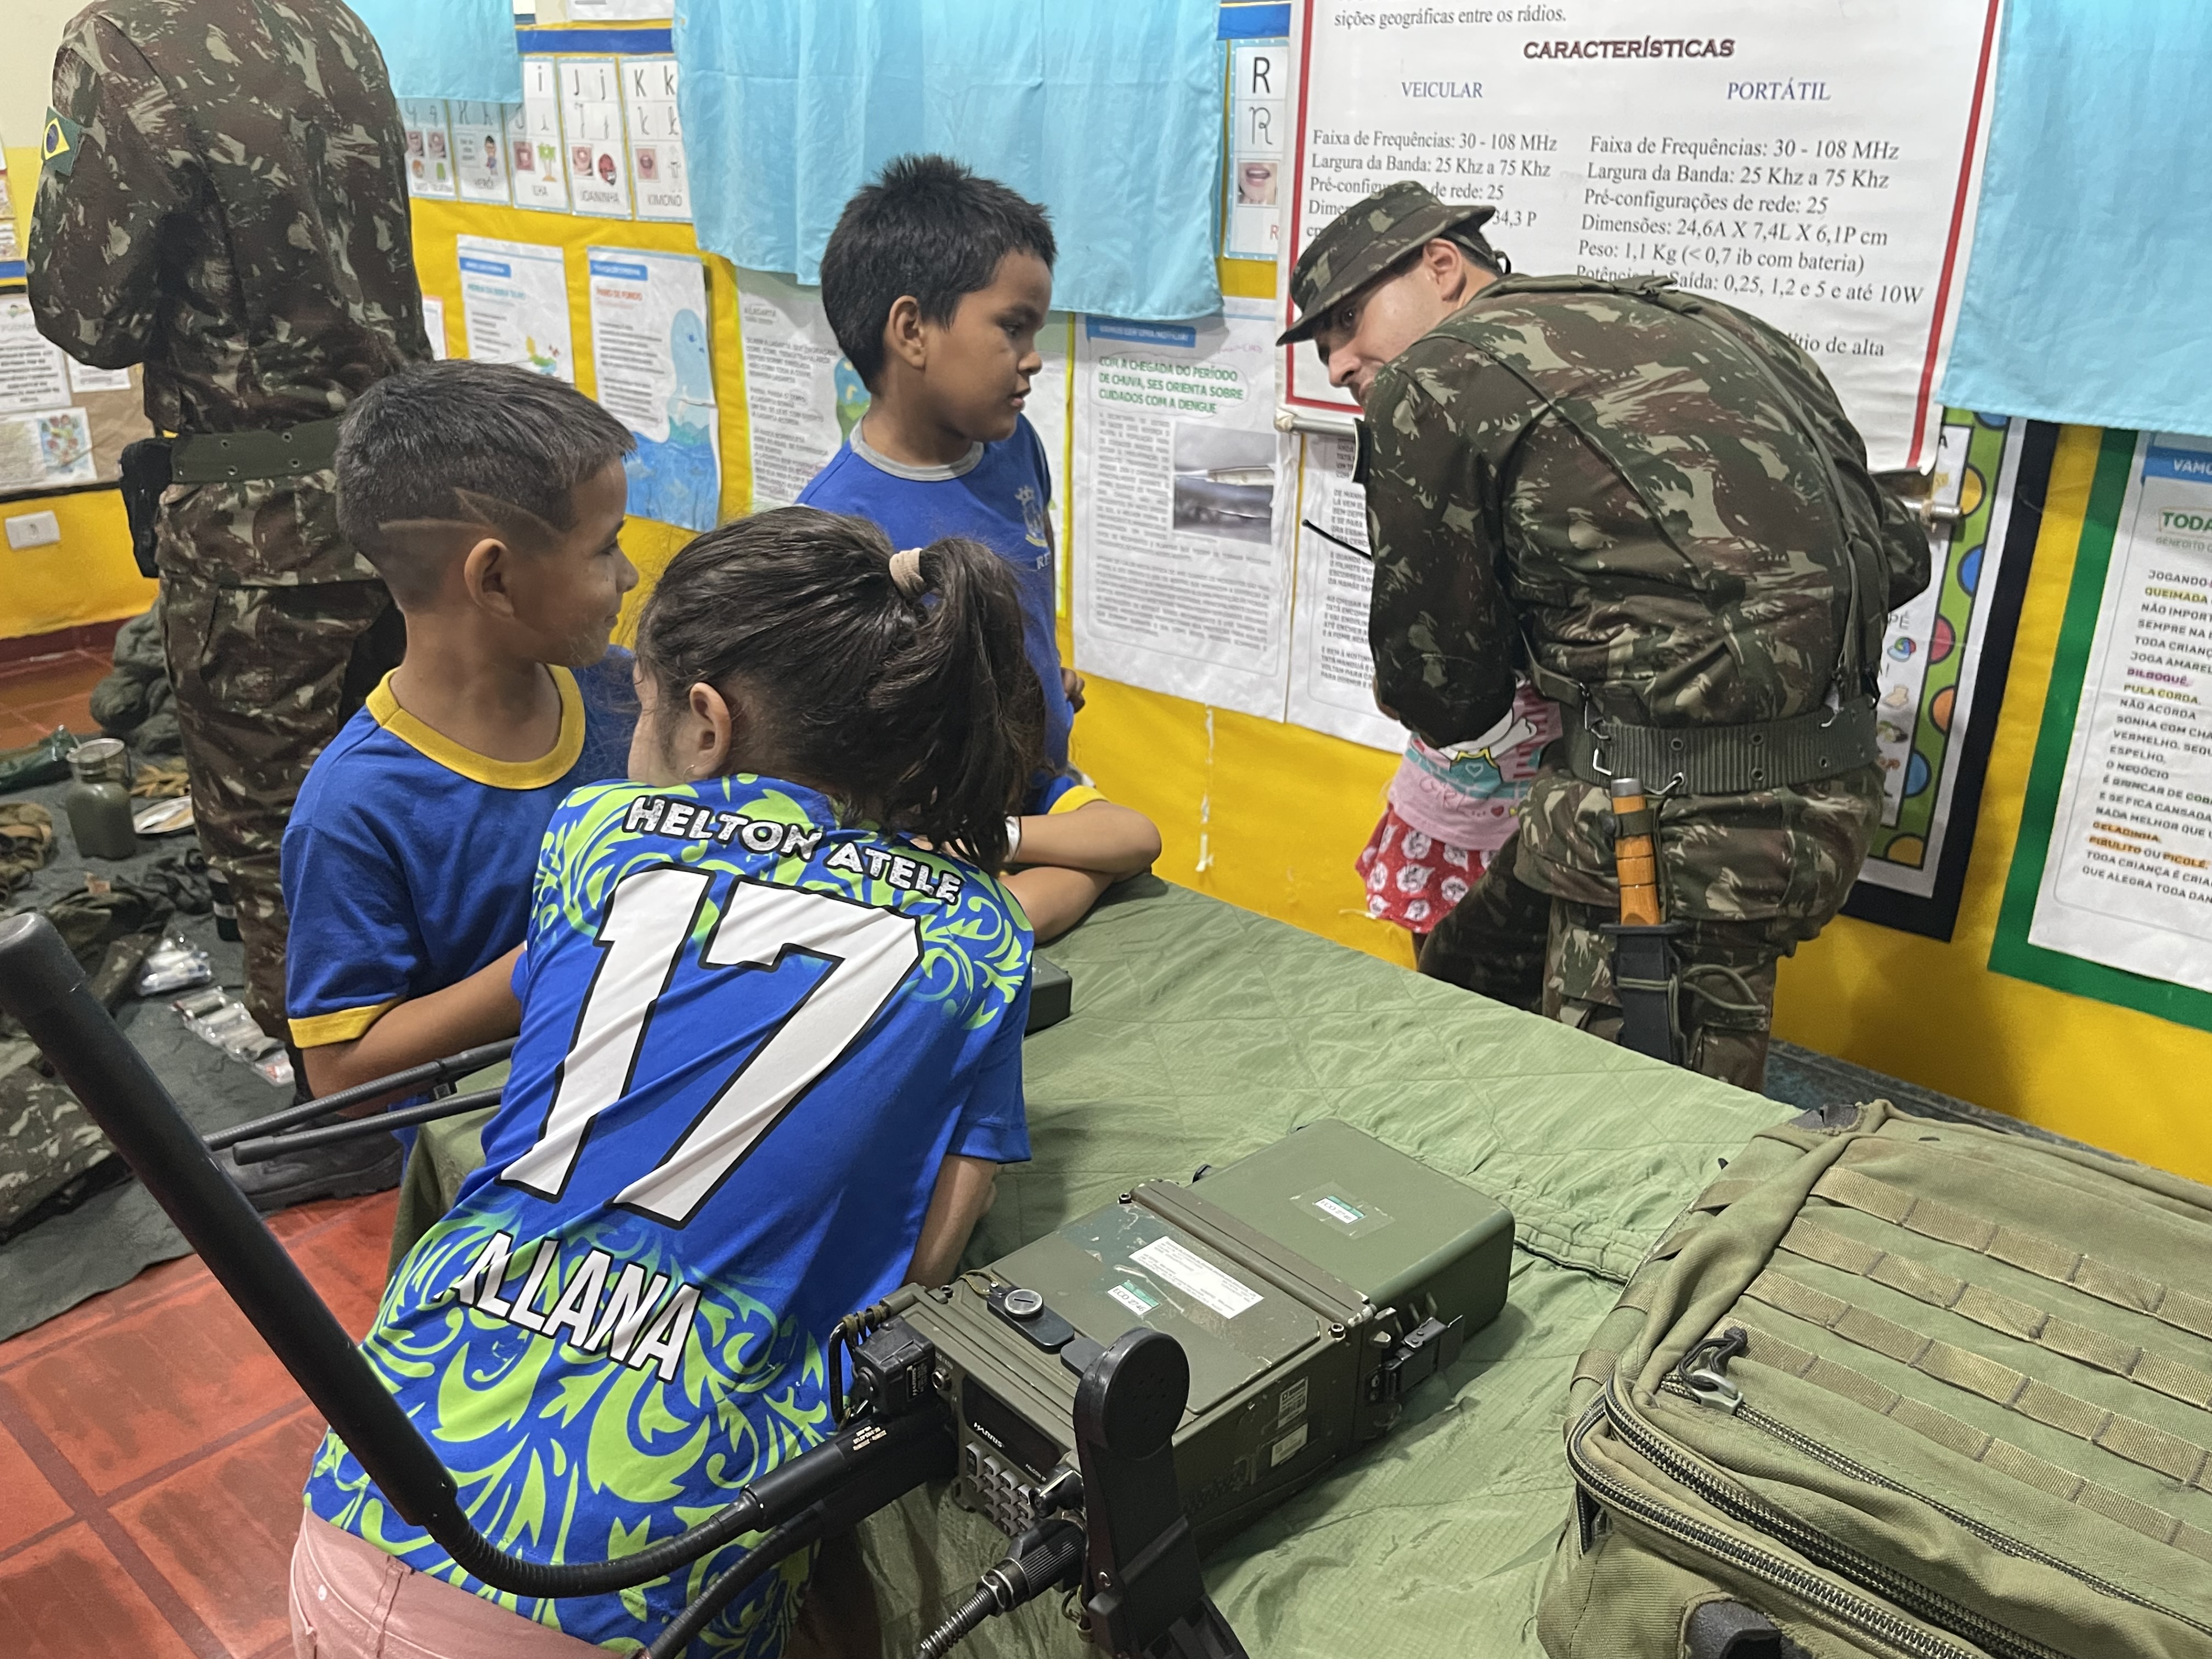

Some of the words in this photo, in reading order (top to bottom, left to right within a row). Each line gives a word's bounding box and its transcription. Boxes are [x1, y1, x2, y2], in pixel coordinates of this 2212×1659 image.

[1334, 10, 1375, 29] sições
[1379, 7, 1455, 29] geográficas
[1458, 9, 1493, 24] entre
[1497, 10, 1513, 22] os
[1517, 4, 1566, 22] rádios.
[1523, 36, 1735, 58] CARACTERÍSTICAS
[634, 69, 647, 97] K
[1253, 57, 1271, 93] R
[1402, 81, 1483, 98] VEICULAR
[1727, 77, 1832, 101] PORTÁTIL
[1313, 129, 1350, 145] Faixa
[1354, 132, 1369, 145] de
[1373, 131, 1455, 150] Frequências:
[1459, 133, 1476, 149] 30
[1491, 134, 1515, 150] 108
[1520, 134, 1558, 151] MHz
[1590, 136, 1632, 154] Faixa
[1638, 138, 1656, 154] de
[1661, 138, 1768, 159] Frequências:
[1773, 139, 1795, 157] 30
[1815, 140, 1846, 159] 108
[1853, 141, 1900, 160] MHz
[1312, 154, 1363, 172] Largura
[1367, 156, 1383, 170] da
[1386, 156, 1431, 172] Banda:
[1435, 157, 1452, 172] 25
[1455, 159, 1483, 174] Khz
[1487, 165, 1495, 174] a
[1499, 160, 1516, 176] 75
[1521, 161, 1551, 177] Khz
[1587, 162, 1647, 184] Largura
[1652, 165, 1671, 182] da
[1677, 166, 1735, 183] Banda:
[1739, 166, 1760, 184] 25
[1768, 167, 1803, 186] Khz
[1809, 174, 1818, 186] a
[1825, 168, 1846, 188] 75
[1852, 170, 1889, 189] Khz
[1430, 182, 1447, 198] de
[1450, 185, 1482, 199] rede:
[1487, 185, 1504, 199] 25
[1584, 188, 1728, 213] Pré-configurações
[1733, 194, 1753, 211] de
[1758, 196, 1801, 213] rede:
[1805, 197, 1828, 215] 25
[1527, 211, 1537, 227] P
[1582, 213, 1672, 234] Dimensões:
[1676, 218, 1726, 239] 24,6A
[1731, 221, 1747, 238] X
[1753, 222, 1791, 242] 7,4L
[1797, 224, 1811, 241] X
[1816, 225, 1856, 245] 6,1P
[1860, 232, 1887, 246] cm
[1579, 239, 1618, 258] Peso:
[1625, 242, 1647, 262] 1,1
[1652, 244, 1677, 264] Kg
[1705, 245, 1731, 265] 0,7
[1757, 254, 1793, 268] com
[1798, 253, 1865, 273] bateria)
[1671, 271, 1718, 290] Saída:
[1724, 275, 1764, 295] 0,25,
[1772, 278, 1795, 296] 1,2
[1801, 285, 1810, 297] e
[1815, 280, 1825, 298] 5
[1831, 287, 1841, 298] e
[1846, 284, 1873, 301] até
[1881, 285, 1924, 304] 10W
[1826, 336, 1846, 353] de
[1852, 337, 1884, 357] alta
[1129, 360, 1174, 375] CHEGADA
[1176, 365, 1190, 376] DO
[1193, 365, 1238, 382] PERÍODO
[1099, 373, 1110, 383] DE
[1147, 379, 1164, 391] SES
[1166, 381, 1207, 397] ORIENTA
[1210, 386, 1244, 400] SOBRE
[1099, 389, 1143, 405] CUIDADOS
[1145, 395, 1167, 407] COM
[1169, 398, 1176, 409] A
[1178, 399, 1217, 414] DENGUE
[2148, 569, 2207, 587] JOGANDO
[2145, 586, 2208, 603] QUEIMADA
[2141, 601, 2166, 615] NÃO
[2138, 618, 2186, 635] SEMPRE
[2189, 628, 2205, 638] NA
[2135, 635, 2165, 648] TODA
[2130, 651, 2163, 665] JOGA
[2124, 684, 2154, 696] PULA
[2120, 698, 2145, 709] NÃO
[2147, 703, 2196, 720] ACORDA
[2117, 715, 2157, 729] SONHA
[2159, 722, 2186, 733] COM
[2106, 760, 2114, 769] O
[2117, 761, 2169, 780] NEGÓCIO
[2113, 777, 2165, 795] BRINCAR
[2167, 788, 2183, 798] DE
[2108, 793, 2124, 803] SE
[2125, 797, 2153, 809] FICA
[2096, 806, 2128, 820] NADA
[2130, 814, 2179, 831] MELHOR
[2181, 823, 2206, 837] QUE
[623, 795, 822, 861] HELTON
[827, 840, 962, 905] ATELE
[2144, 848, 2161, 860] OU
[2086, 850, 2115, 864] TODA
[2118, 859, 2169, 877] CRIANÇA
[2082, 865, 2104, 877] QUE
[2107, 872, 2152, 889] ALEGRA
[2155, 883, 2186, 898] TODA
[495, 863, 923, 1229] 17
[1113, 1288, 1129, 1300] ECO
[431, 1229, 703, 1384] ALLANA
[974, 1422, 1002, 1447] HARRIS
